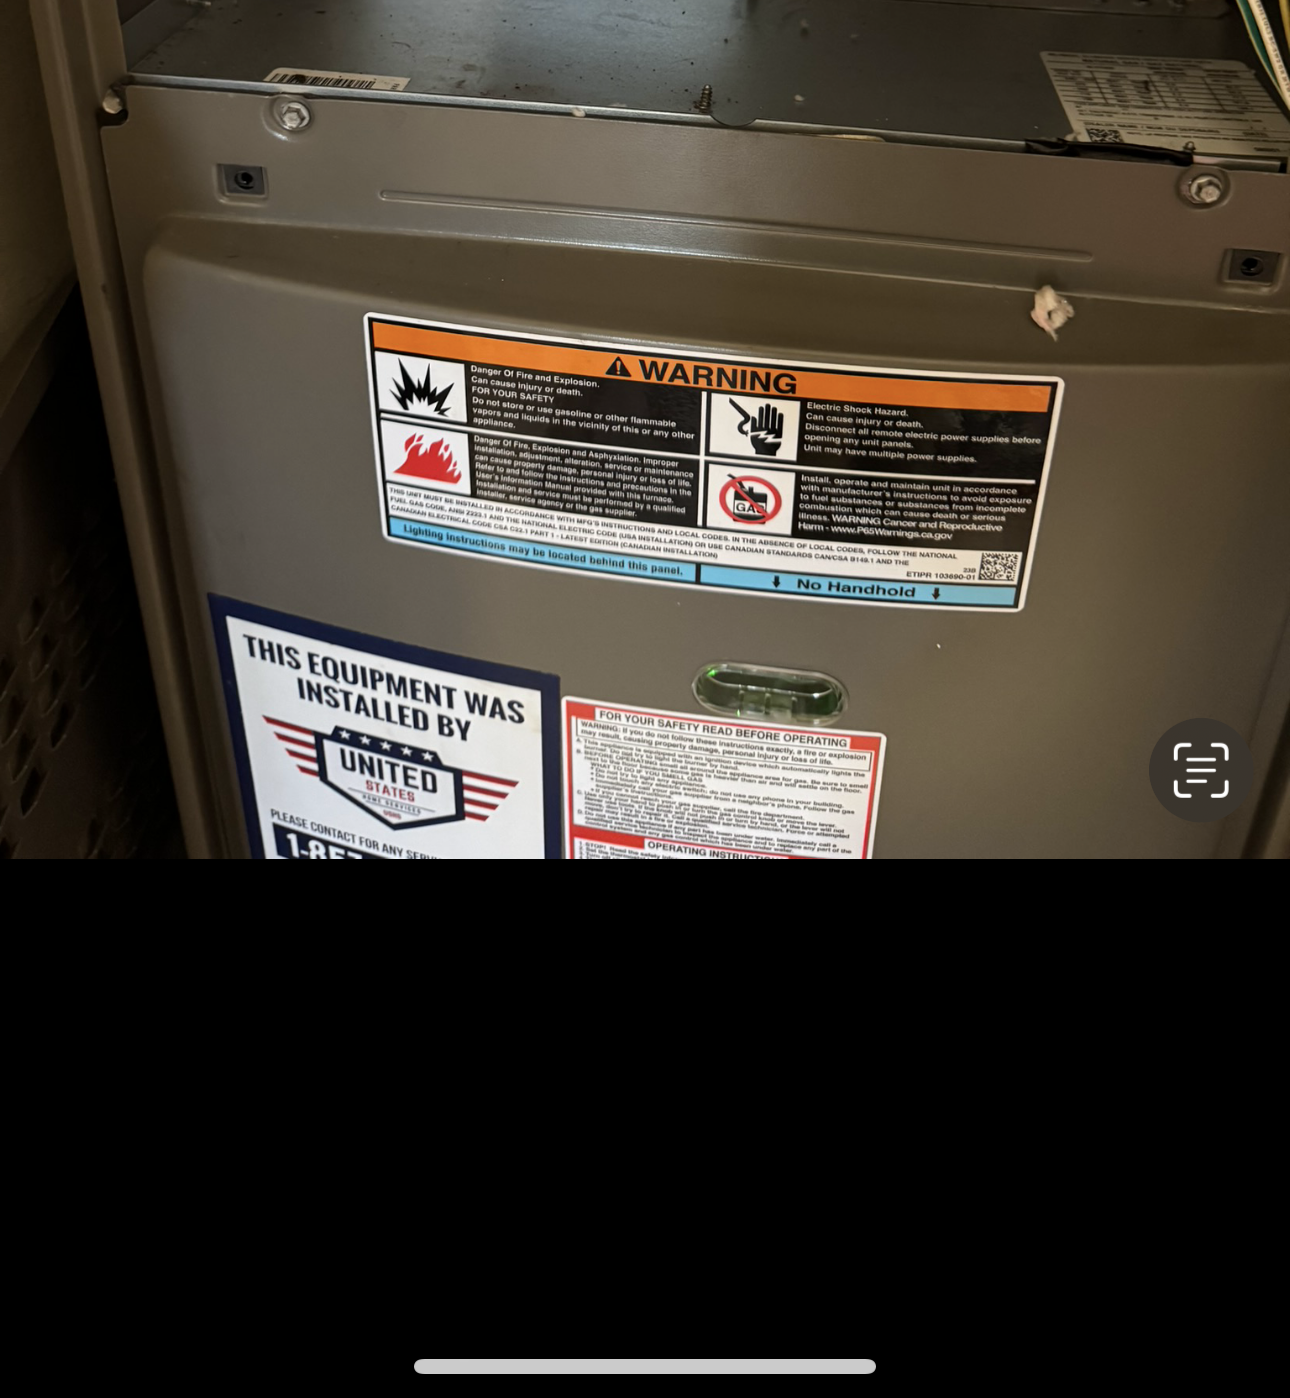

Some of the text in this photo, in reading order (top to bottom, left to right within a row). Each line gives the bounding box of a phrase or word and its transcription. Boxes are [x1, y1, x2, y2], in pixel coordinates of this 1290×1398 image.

[470, 364, 599, 387] Danger Of Fire and Explosion.
[470, 375, 488, 384] Can
[489, 379, 516, 388] cause
[517, 381, 542, 393] injury
[556, 387, 582, 396] death.
[639, 359, 797, 394] WARNING
[471, 385, 554, 403] FOR YOUR SAFETY
[472, 396, 484, 404] Do
[502, 401, 524, 410] store
[554, 408, 591, 418] gasoline
[605, 414, 628, 422] other
[630, 416, 676, 427] flammable
[806, 401, 908, 416] Electric Shock Hazard.
[472, 407, 501, 417] vapors
[503, 411, 519, 419] and
[521, 412, 550, 423] liquids
[562, 418, 576, 426] the
[578, 421, 609, 431] vicinity
[622, 425, 639, 433] this
[653, 429, 669, 438] any
[671, 430, 694, 439] other
[473, 417, 515, 428] appliance.
[805, 412, 823, 420] Can
[826, 415, 853, 423] cause
[855, 417, 881, 426] injury
[895, 419, 923, 428] death.
[804, 434, 840, 444] opening
[842, 437, 859, 445] any
[881, 440, 913, 448] panels.
[805, 422, 855, 434] Disconnect
[871, 429, 903, 437] remote
[904, 431, 938, 439] electric
[971, 435, 1009, 443] supplies
[1011, 435, 1041, 444] before
[803, 443, 821, 452] Unit
[824, 447, 842, 455] may
[845, 447, 866, 455] have
[868, 450, 905, 459] multiple
[937, 454, 976, 462] supplies.
[821, 486, 890, 497] manufacturer's
[892, 491, 947, 500] instructions
[833, 478, 868, 486] operate
[890, 482, 930, 490] maintain
[963, 486, 1017, 494] accordance
[798, 502, 852, 512] combustion
[902, 510, 930, 518] cause
[931, 511, 958, 519] death
[799, 492, 809, 500] to
[811, 493, 828, 501] fuel
[830, 496, 882, 505] substances
[897, 501, 949, 510] substances
[975, 504, 1026, 513] incomplete
[798, 521, 823, 530] Harm
[831, 513, 881, 525] WARNING
[882, 517, 917, 527] Cancer
[938, 521, 1003, 531] Reproductive
[403, 523, 682, 575] Lighting instructions may be located behind this panel.
[797, 578, 915, 597] No Handhold
[242, 634, 525, 724] THIS EQUIPMENT WAS
[296, 678, 472, 741] INSTALLED BY
[599, 710, 847, 747] FOR YOUR SAFETY READ BEFORE OPERATING
[340, 747, 438, 794] UNITED
[366, 780, 415, 803] STATES
[385, 799, 421, 814] SERVICES
[270, 808, 308, 830] PLEASE
[310, 822, 356, 844] CONTACT
[359, 836, 380, 850] FOR
[382, 844, 404, 857] ANY
[647, 841, 707, 857] OPERATING
